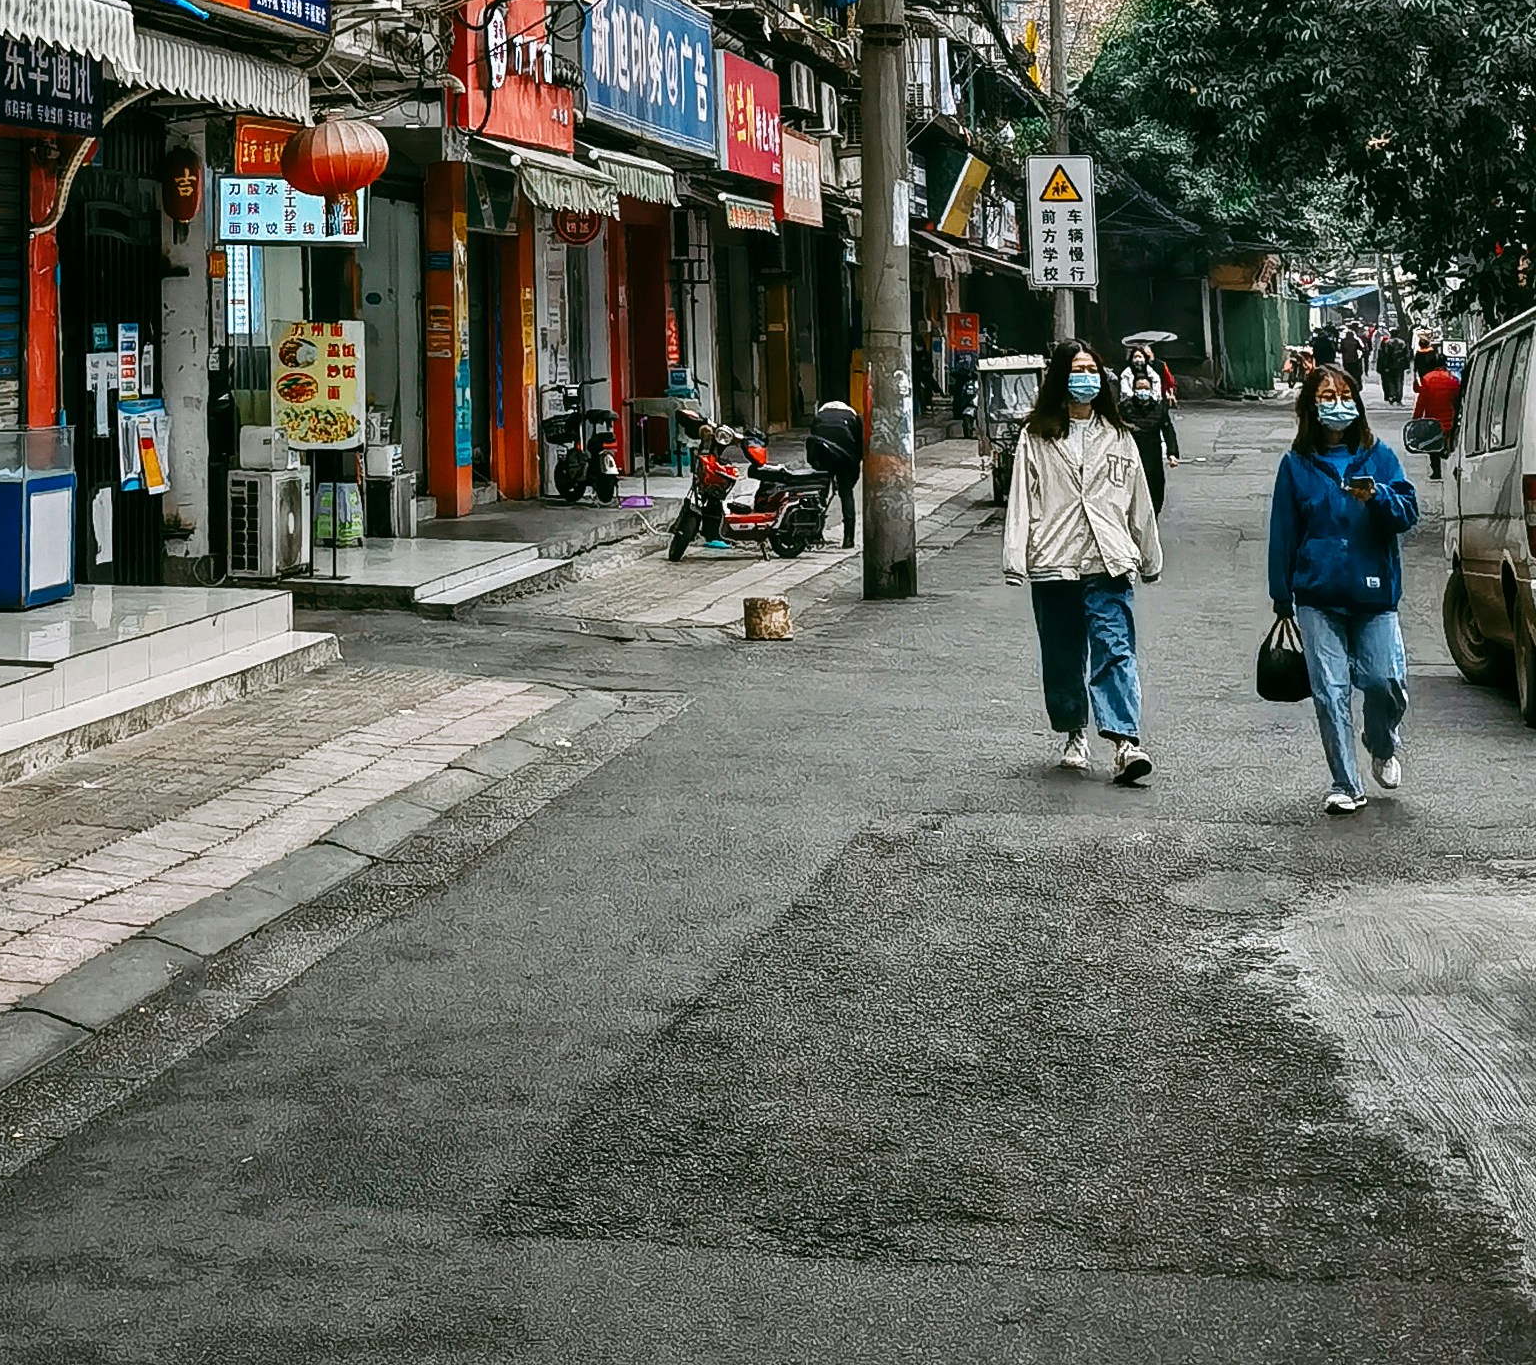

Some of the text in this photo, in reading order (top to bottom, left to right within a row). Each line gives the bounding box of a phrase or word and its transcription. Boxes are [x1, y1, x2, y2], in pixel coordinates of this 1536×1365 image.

[4, 33, 94, 105] 东华通讯
[228, 183, 242, 235] 刀削面
[247, 182, 260, 235] 酸辣粉
[1041, 208, 1060, 283] 前方学校
[1067, 208, 1086, 283] 车辆慢行
